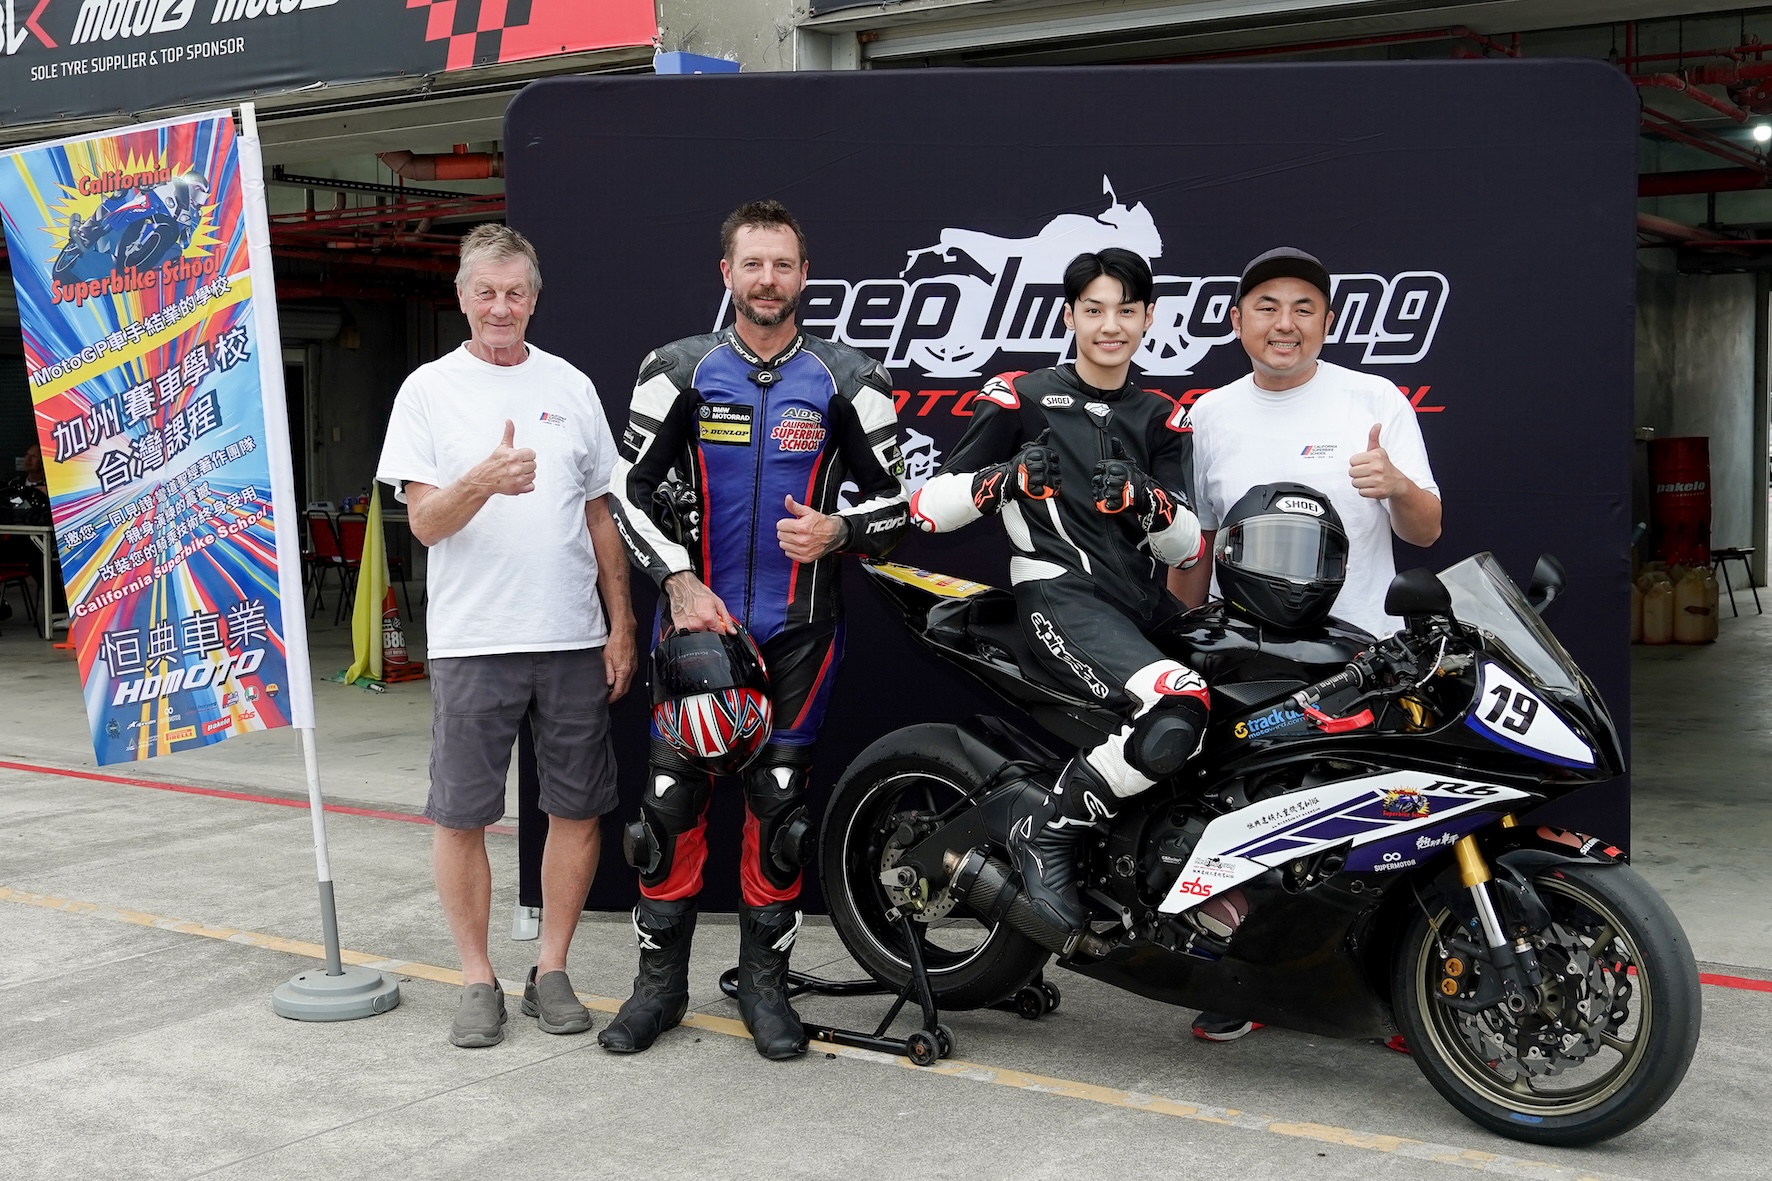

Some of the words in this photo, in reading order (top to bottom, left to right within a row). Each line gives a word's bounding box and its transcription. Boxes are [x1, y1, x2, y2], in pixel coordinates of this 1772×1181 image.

[31, 64, 59, 81] SOLE
[61, 59, 89, 77] TYRE
[91, 52, 147, 73] SUPPLIER
[149, 50, 158, 65] &
[161, 46, 184, 63] TOP
[187, 37, 245, 60] SPONSOR
[78, 163, 172, 197] California
[51, 270, 157, 308] Superbike
[163, 247, 222, 284] School
[33, 275, 232, 387] MotoGP車手結業的學校
[1046, 396, 1070, 405] SHOEI
[712, 406, 730, 414] BMW
[712, 412, 751, 421] MOTORRAD
[710, 429, 749, 437] DUNLOP
[781, 420, 820, 430] CALIFORNIA
[99, 392, 219, 493] 台灣課程
[771, 427, 826, 442] SUPERBIKE
[779, 439, 820, 452] SCHOOL
[1656, 481, 1706, 494] pakelo
[1284, 499, 1319, 513] SHOEI
[613, 513, 651, 568] ricondi
[75, 575, 153, 618] California
[154, 533, 216, 580] Superbike
[216, 505, 268, 540] School
[1031, 612, 1110, 699] alpinestars
[237, 710, 256, 722] sbs
[1484, 683, 1540, 736] 19
[206, 717, 232, 732] pakelo
[1247, 708, 1284, 733] track
[1179, 877, 1213, 897] sbs
